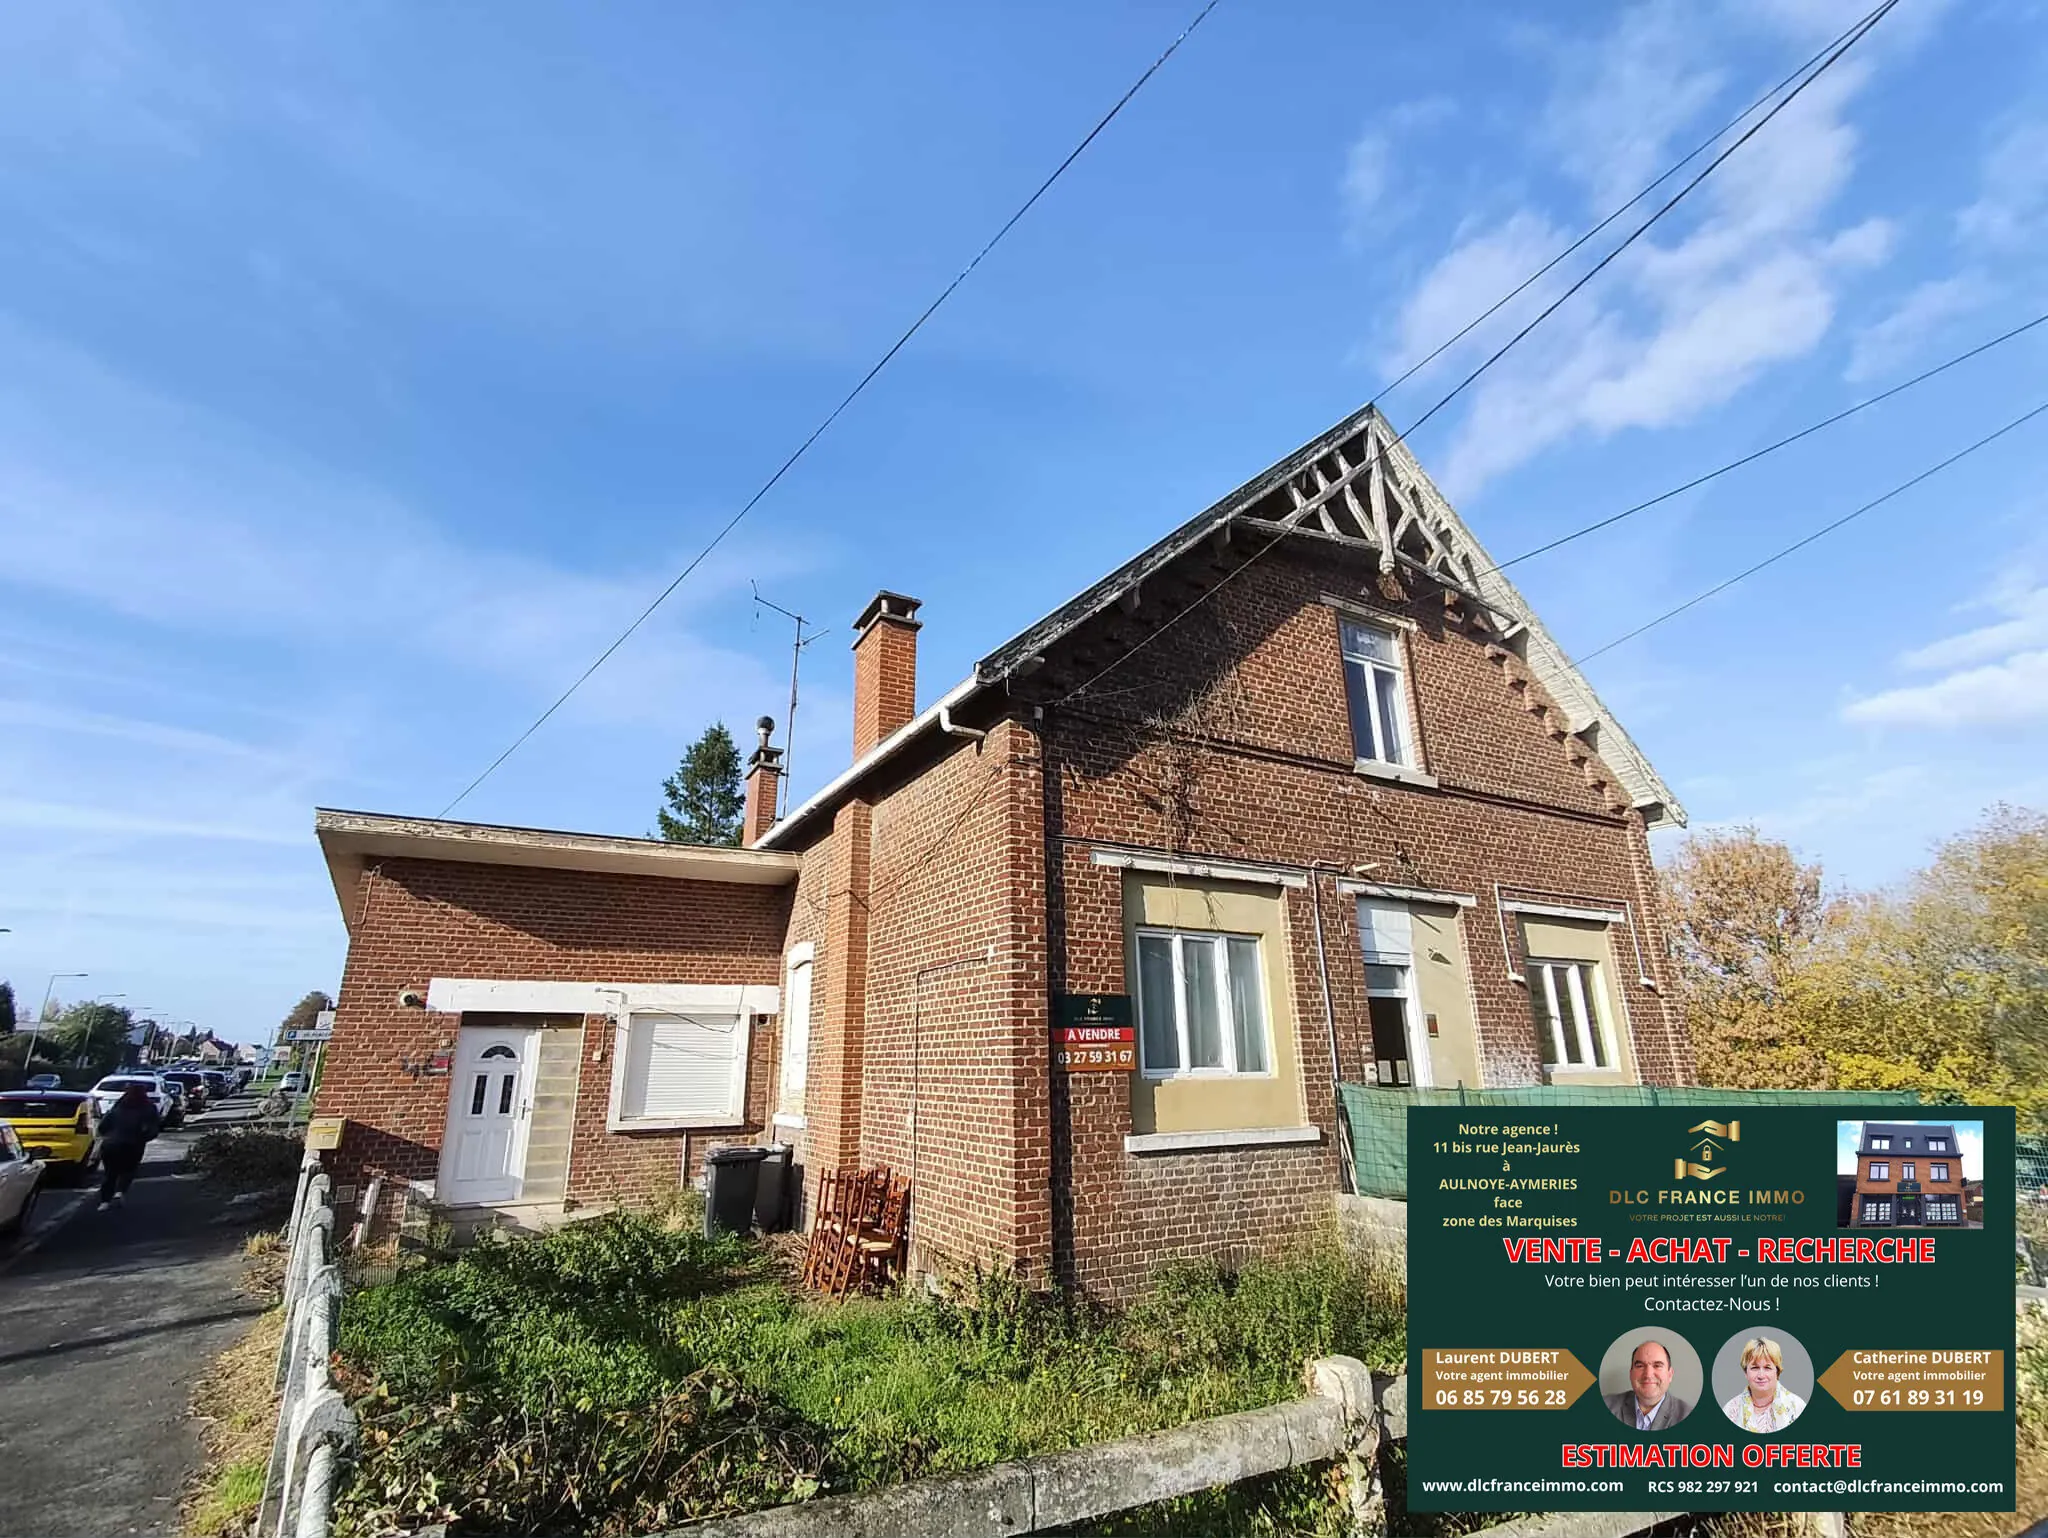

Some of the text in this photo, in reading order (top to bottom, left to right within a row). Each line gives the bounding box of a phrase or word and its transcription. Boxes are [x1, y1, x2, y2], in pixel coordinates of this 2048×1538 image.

[1068, 1028, 1121, 1041] A VENDRE
[1058, 1050, 1132, 1065] 03 27 59 31 67
